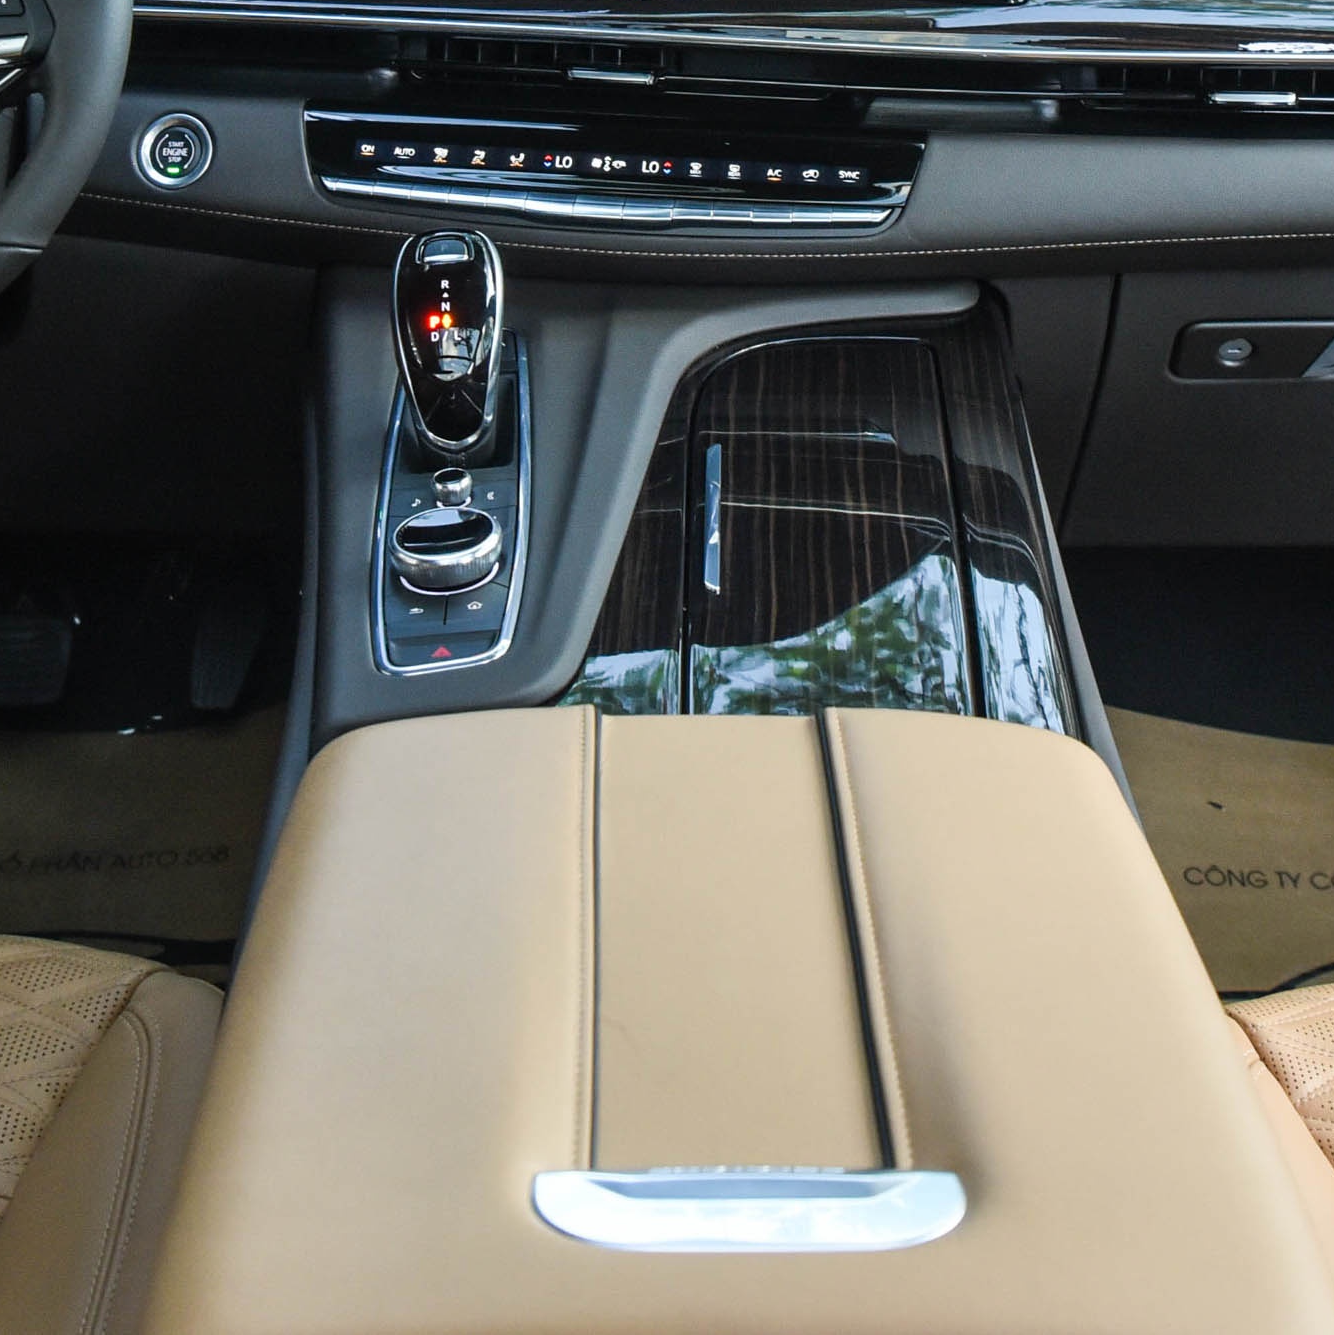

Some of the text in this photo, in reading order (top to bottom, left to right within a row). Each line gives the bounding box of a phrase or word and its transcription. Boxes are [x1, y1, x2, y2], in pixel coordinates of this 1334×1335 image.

[162, 147, 189, 157] ENGINE
[361, 144, 375, 153] ON
[394, 146, 415, 157] AUTO
[555, 156, 573, 168] LO
[642, 161, 659, 174] LO
[767, 168, 783, 178] A/C
[838, 170, 860, 180] SYNC
[440, 280, 450, 289] R
[441, 302, 450, 311] N
[429, 315, 440, 329] P
[1184, 865, 1268, 889] CÔNG
[1275, 870, 1301, 889] TY
